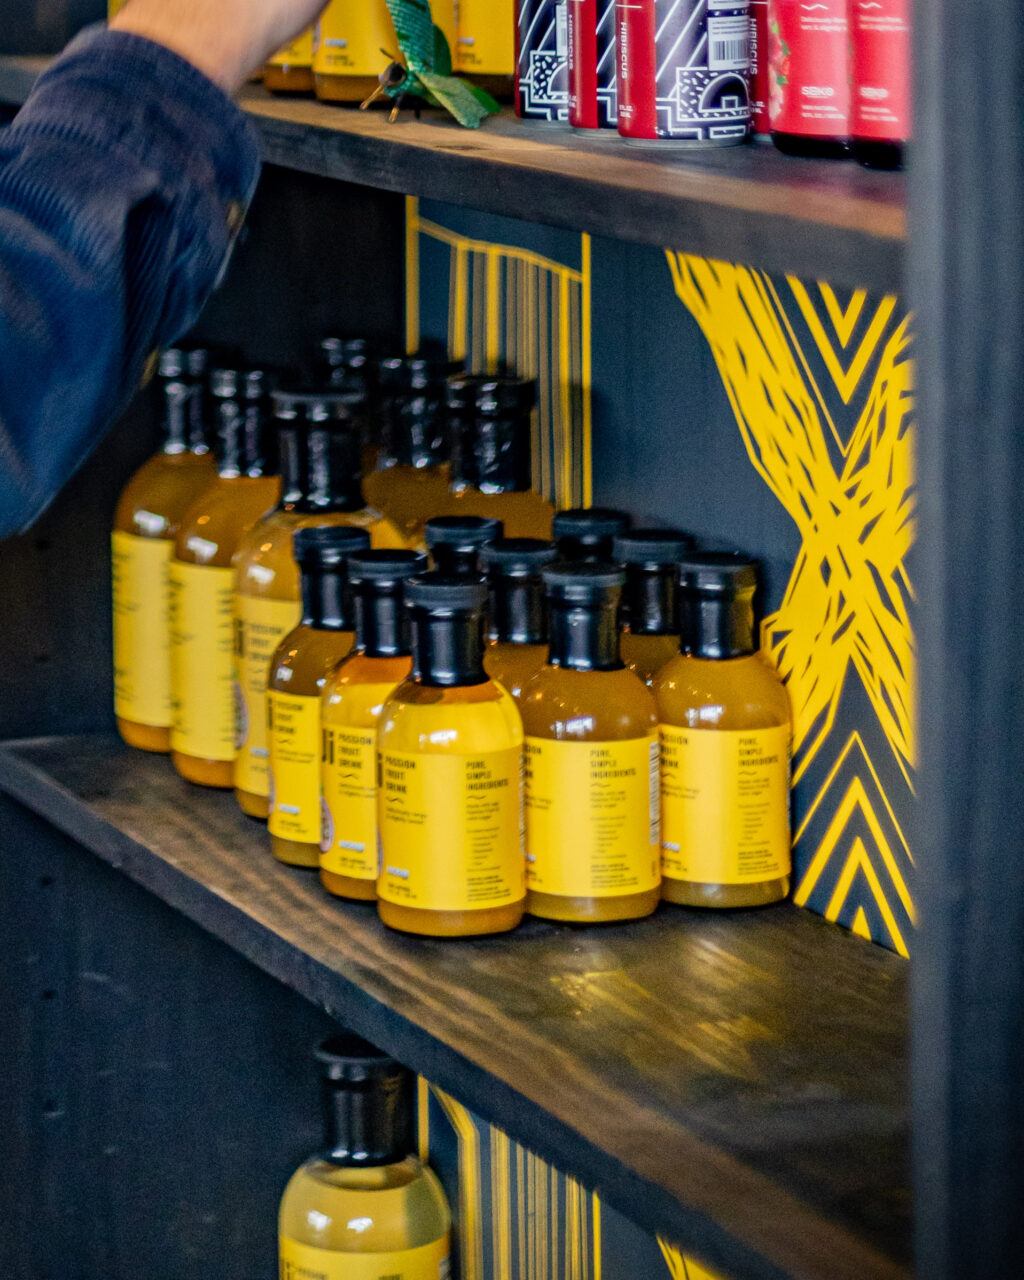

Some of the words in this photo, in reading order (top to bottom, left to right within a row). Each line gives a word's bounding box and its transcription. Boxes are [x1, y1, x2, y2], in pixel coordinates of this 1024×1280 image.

[621, 21, 629, 80] HIBISCUS
[386, 756, 416, 769] PASSION
[386, 782, 407, 794] DRINK
